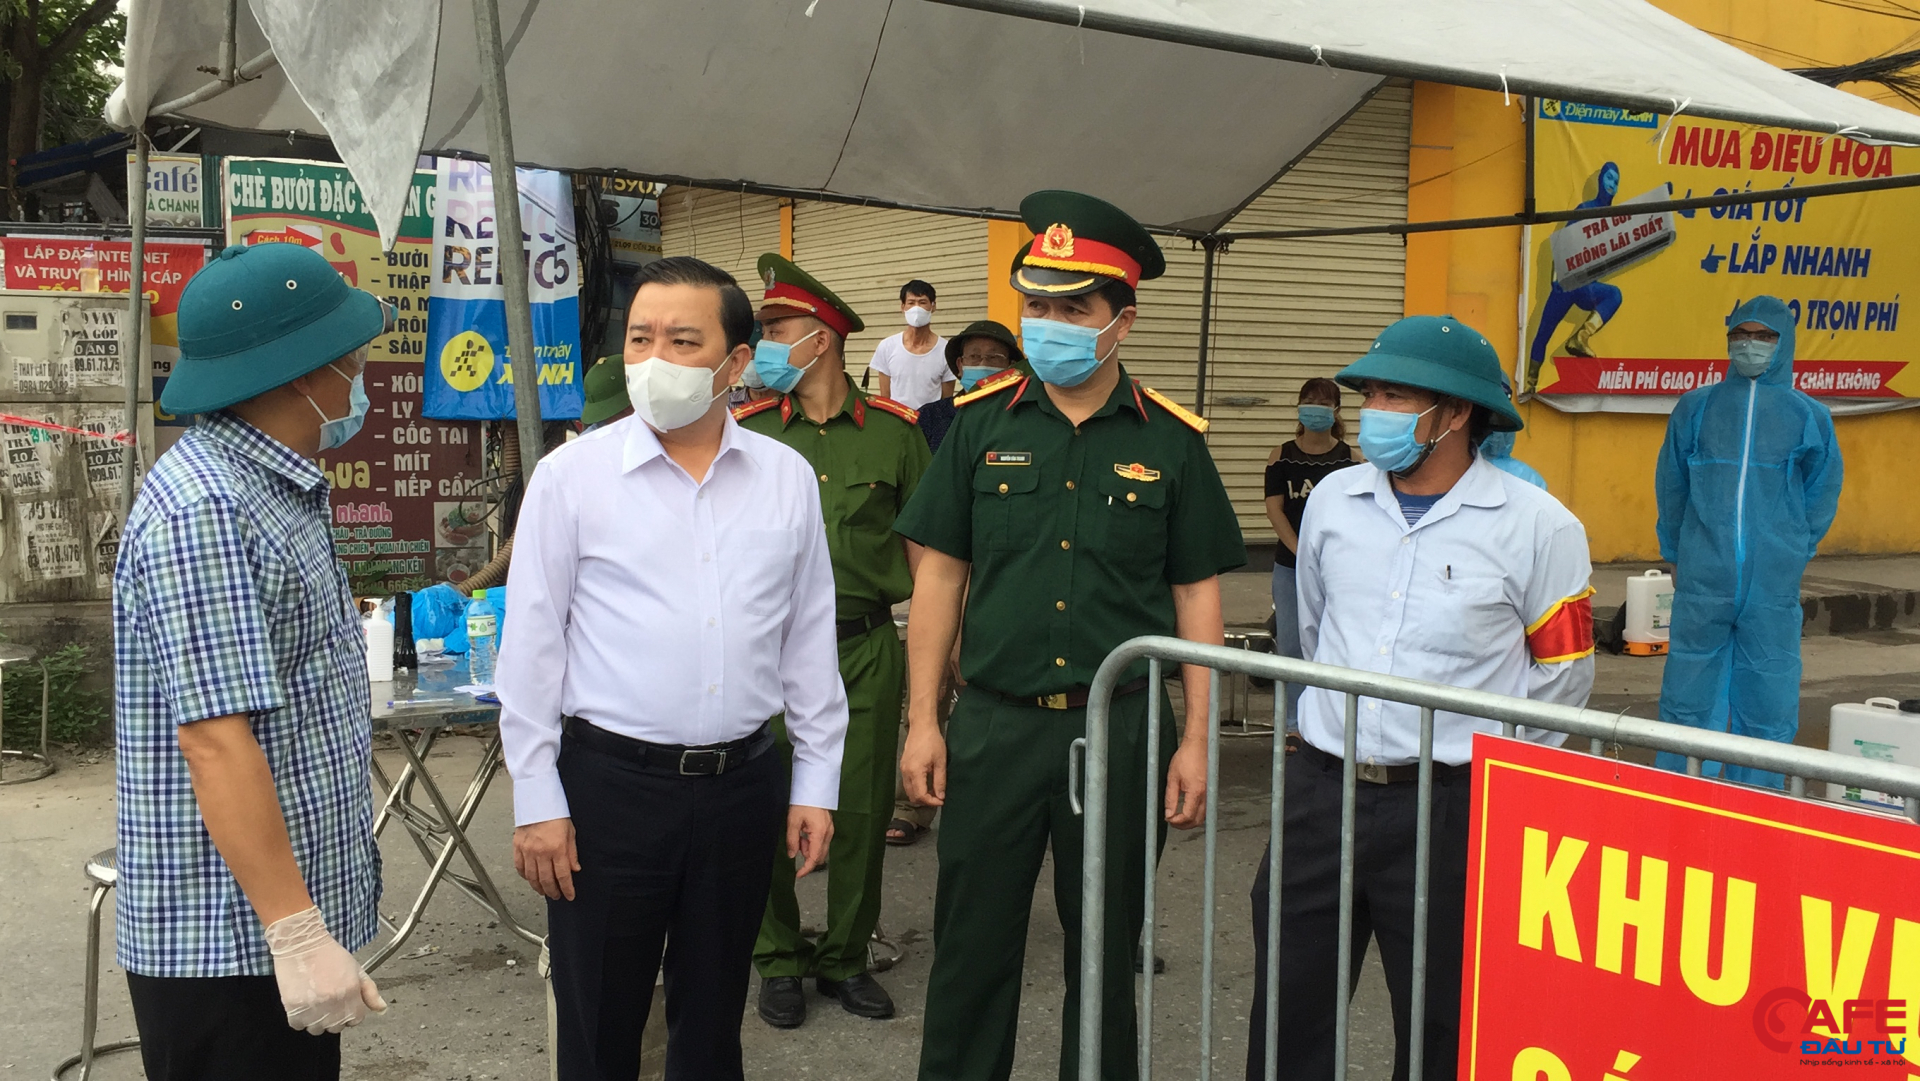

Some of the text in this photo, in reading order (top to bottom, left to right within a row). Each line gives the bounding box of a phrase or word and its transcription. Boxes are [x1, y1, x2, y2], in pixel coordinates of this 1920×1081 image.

[1564, 102, 1593, 119] Điện
[1594, 107, 1621, 121] máy
[1669, 126, 1741, 169] MUA
[146, 165, 198, 193] afé
[230, 168, 266, 208] CHÈ
[271, 169, 316, 211] BƯỞI
[320, 173, 356, 221] ĐẶC
[158, 198, 199, 213] CHANH
[24, 243, 55, 261] LẮP
[1565, 212, 1664, 272] KHÔNG LÃI SUẤT
[1728, 225, 1872, 278] LẮP NHANH
[387, 248, 429, 268] BƯỞI
[14, 264, 37, 279] VÀ
[150, 269, 182, 285] CÁP
[387, 271, 431, 293] THẬP
[92, 312, 117, 326] VAY
[1806, 299, 1861, 340] TRỌN
[1864, 292, 1900, 332] PHÍ
[92, 326, 117, 339] GÓP
[108, 344, 117, 355] 9
[388, 334, 423, 355] SẦU
[391, 372, 424, 393] XÔI
[496, 361, 575, 386] XNH
[1598, 362, 1634, 389] MIỄN
[1635, 366, 1660, 390] PHÍ
[1660, 371, 1695, 390] GIAO
[1696, 362, 1723, 389] LẮP
[1800, 367, 1835, 390] CHÂN
[1836, 368, 1881, 390] KHÔNG
[392, 401, 414, 419] LY
[392, 420, 469, 445] CỐC TAI
[13, 452, 28, 463] 10
[88, 454, 103, 466] 10
[393, 450, 431, 471] MÍT
[394, 471, 483, 497] NẾP CẨM
[337, 501, 392, 523] nhanh
[102, 545, 115, 555] 10
[1518, 826, 1757, 1007] KHU
